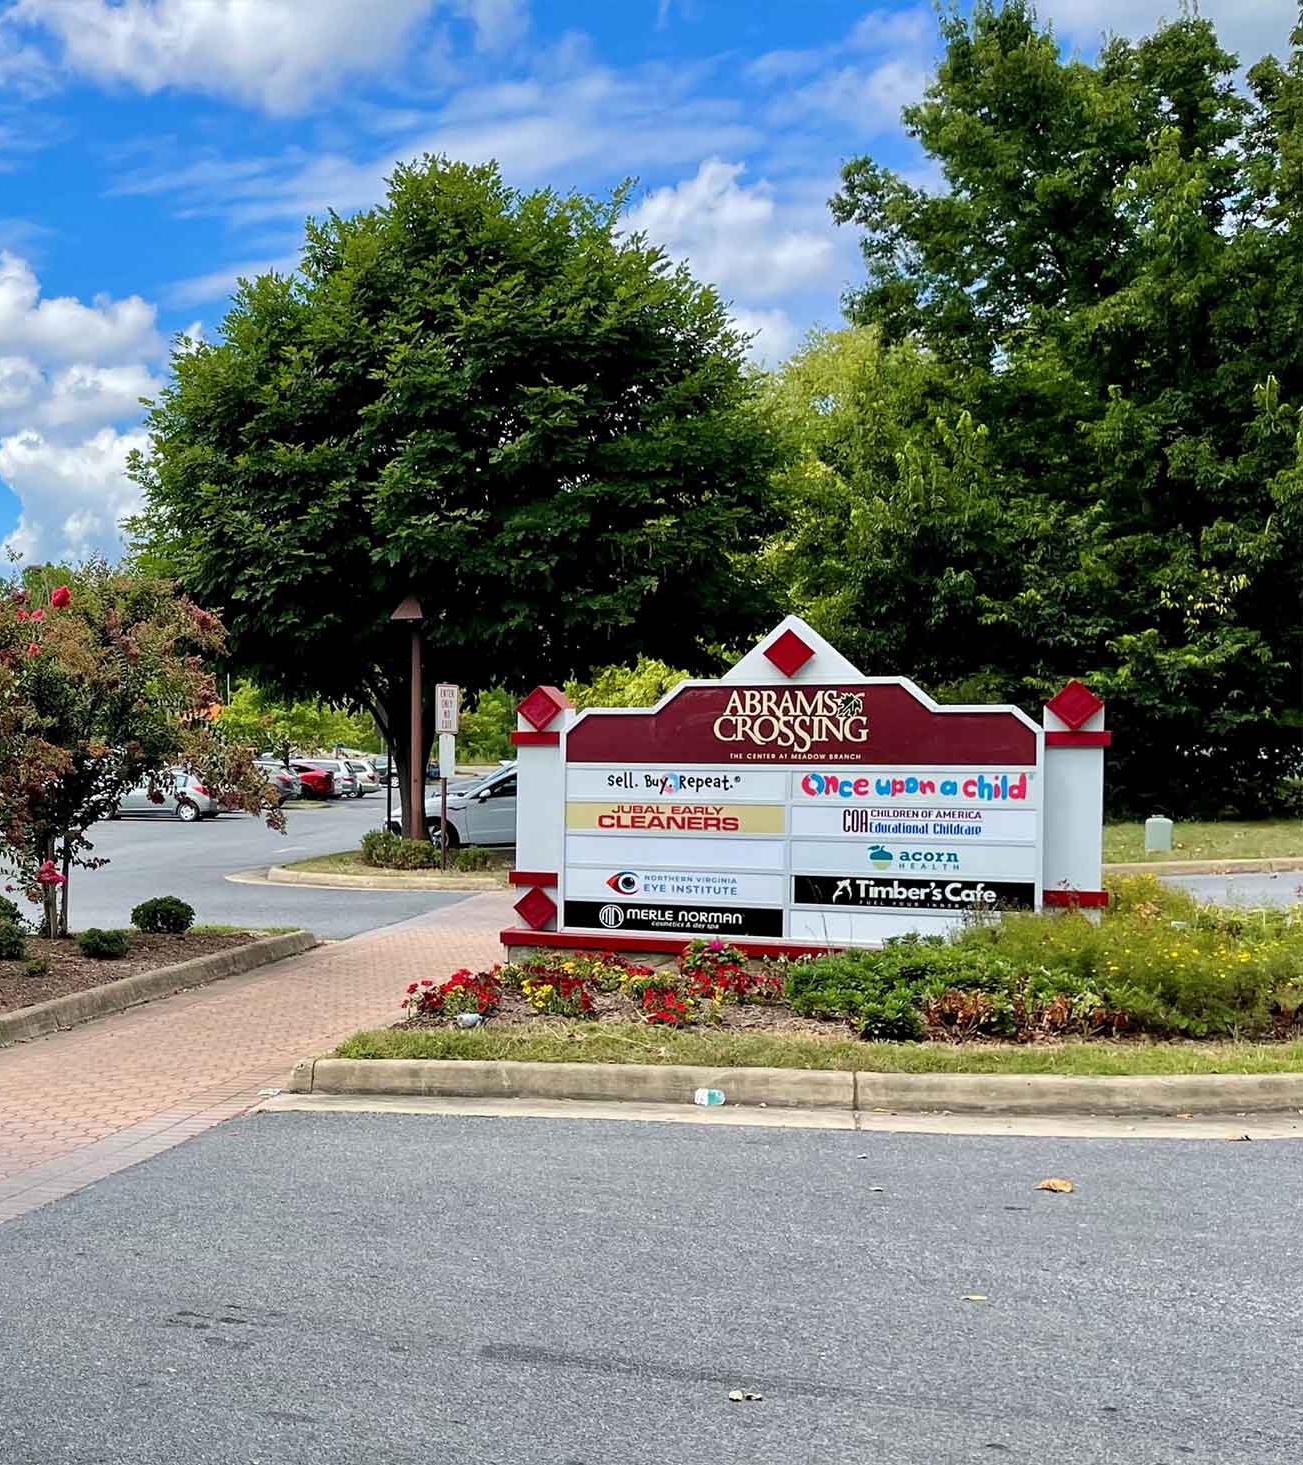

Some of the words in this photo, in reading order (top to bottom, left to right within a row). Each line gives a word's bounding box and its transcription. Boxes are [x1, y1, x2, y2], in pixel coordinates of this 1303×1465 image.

[723, 690, 838, 716] ABRAMS
[713, 715, 869, 752] CROSSING
[644, 774, 673, 794] Buy.
[801, 773, 869, 797] Once
[875, 777, 935, 797] upon
[940, 780, 957, 796] a
[962, 772, 1027, 800] child
[611, 805, 665, 814] JUBAL
[671, 806, 724, 815] EARLY
[870, 810, 919, 819] CHILDREN
[921, 810, 932, 819] OF
[935, 811, 982, 820] AMERICA
[598, 815, 739, 831] CLEANERS
[842, 809, 868, 833] COA
[869, 821, 929, 835] Educational
[933, 823, 982, 836] Childcare
[899, 850, 959, 863] acorn
[644, 874, 693, 882] NORTHERN
[697, 876, 737, 884] VIRGINIA
[644, 884, 665, 893] EYE
[671, 885, 737, 896] INSTITUTE
[944, 882, 997, 903] Cafe
[626, 908, 674, 921] MERLE
[678, 910, 743, 925] NORMAN
